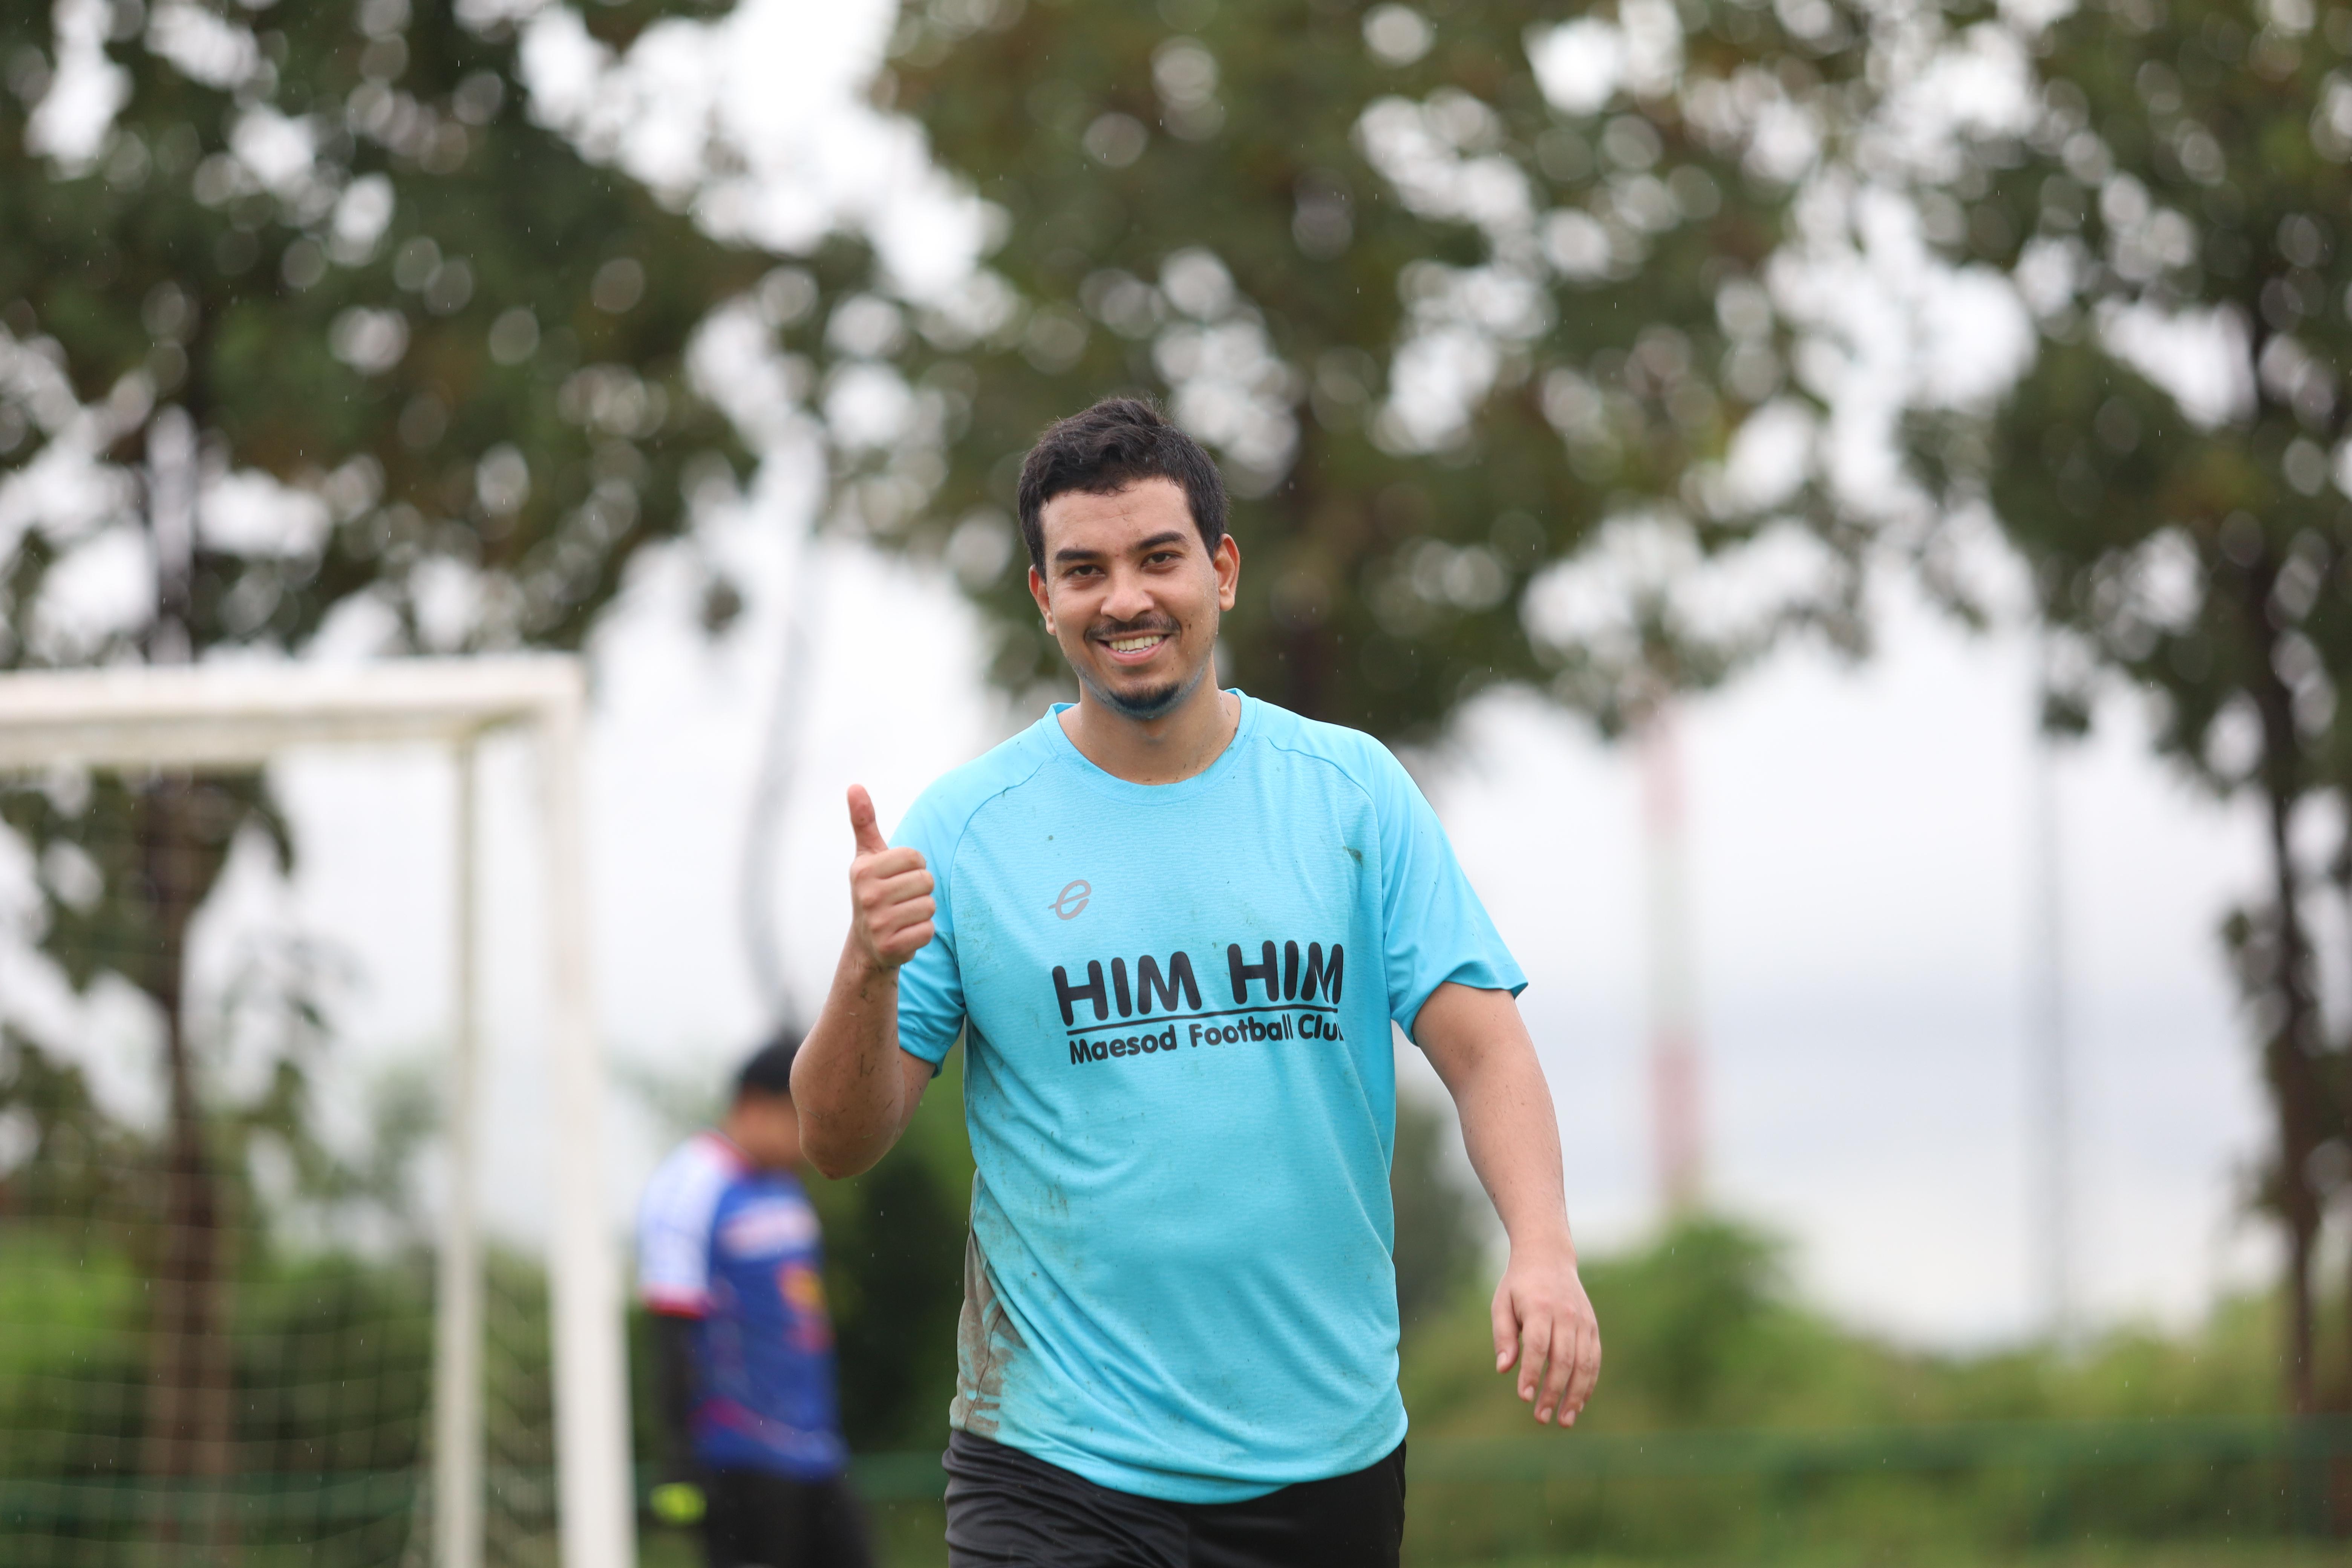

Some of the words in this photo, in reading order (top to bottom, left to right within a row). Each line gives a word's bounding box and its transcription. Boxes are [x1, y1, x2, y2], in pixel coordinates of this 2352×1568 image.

[1052, 951, 1202, 1027] HIM
[1227, 940, 1344, 1005] HIM
[1069, 1024, 1178, 1065] Maesod
[1189, 1013, 1294, 1047] Football
[1297, 1013, 1344, 1041] Clu
